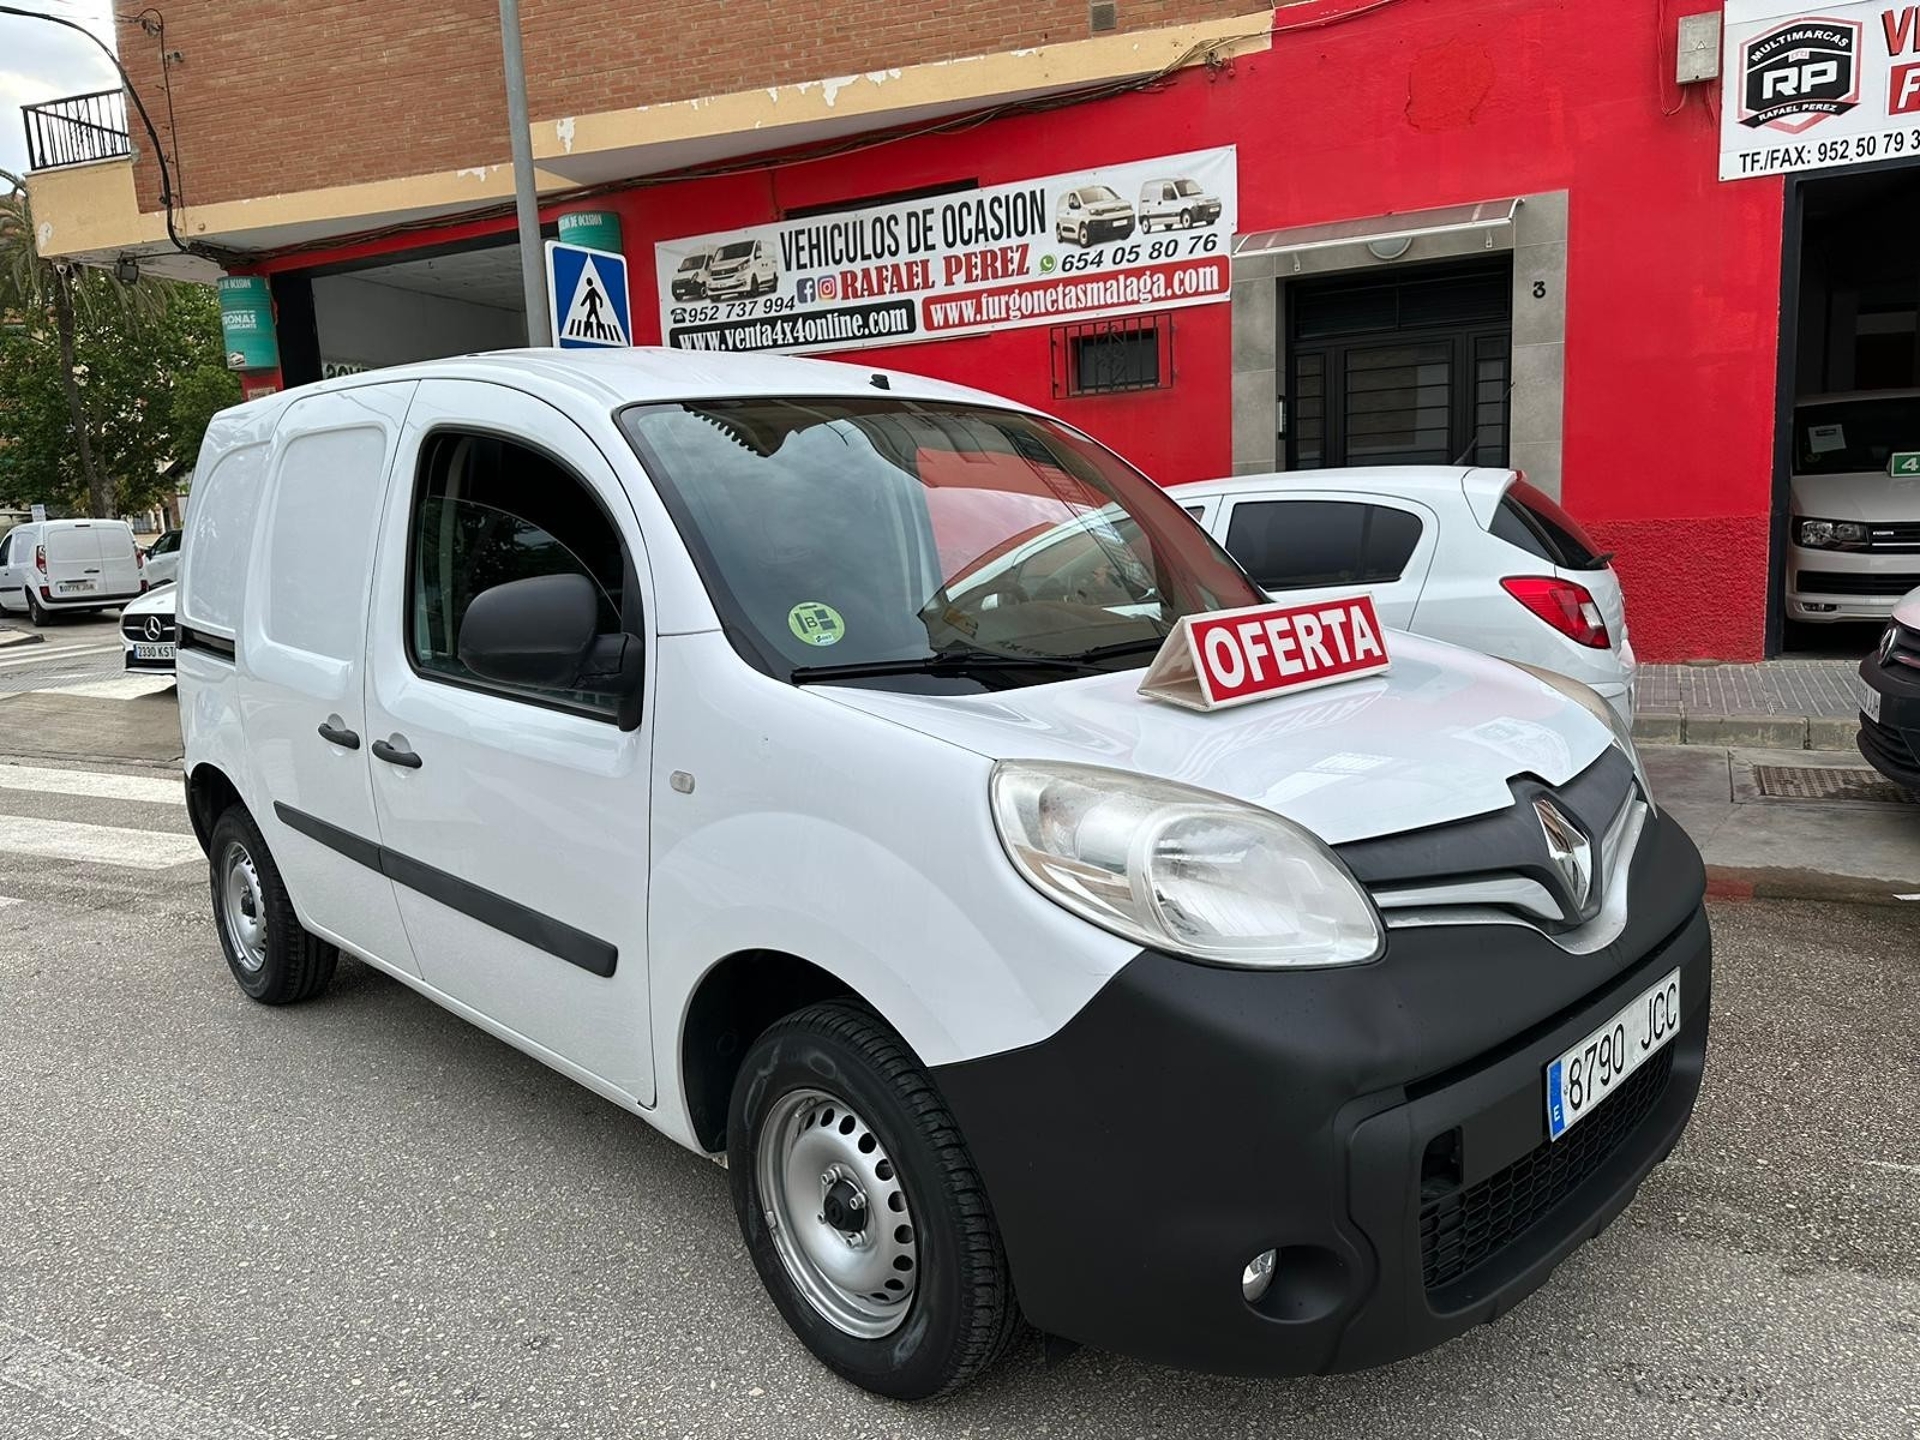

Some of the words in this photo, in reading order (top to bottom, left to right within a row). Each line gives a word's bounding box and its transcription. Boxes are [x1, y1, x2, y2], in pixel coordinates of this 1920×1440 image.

[1751, 30, 1849, 62] MULTIMARCAS
[1881, 5, 1920, 56] V
[1763, 60, 1837, 99] RP
[1897, 68, 1920, 110] F
[1758, 105, 1799, 121] RAFAEL
[1802, 103, 1837, 112] PEREZ
[1739, 145, 1811, 173] TF./FAX:
[1855, 136, 1876, 158] 50
[1883, 131, 1904, 154] 79
[780, 213, 900, 272] VEHICULOS
[906, 207, 936, 254] DE
[942, 188, 1046, 249] OCASION
[839, 258, 935, 300] RAFAEL
[943, 243, 1030, 286] PEREZ
[1061, 250, 1104, 272] 654
[1112, 244, 1141, 265] 05
[1148, 239, 1179, 260] 80
[1188, 233, 1218, 255] 76
[688, 305, 720, 323] 952
[725, 301, 758, 319] 737
[763, 295, 796, 314] 994
[930, 264, 1219, 327] www.furgonetasmalaga.com
[1533, 280, 1546, 299] 3
[679, 307, 909, 351] www.venta4x4online.com
[1901, 457, 1919, 471] 4
[805, 616, 818, 628] B
[1204, 605, 1382, 689] OFERTA
[1553, 1104, 1561, 1122] E
[1569, 1023, 1624, 1110] 8790
[1641, 982, 1677, 1050] JCC
